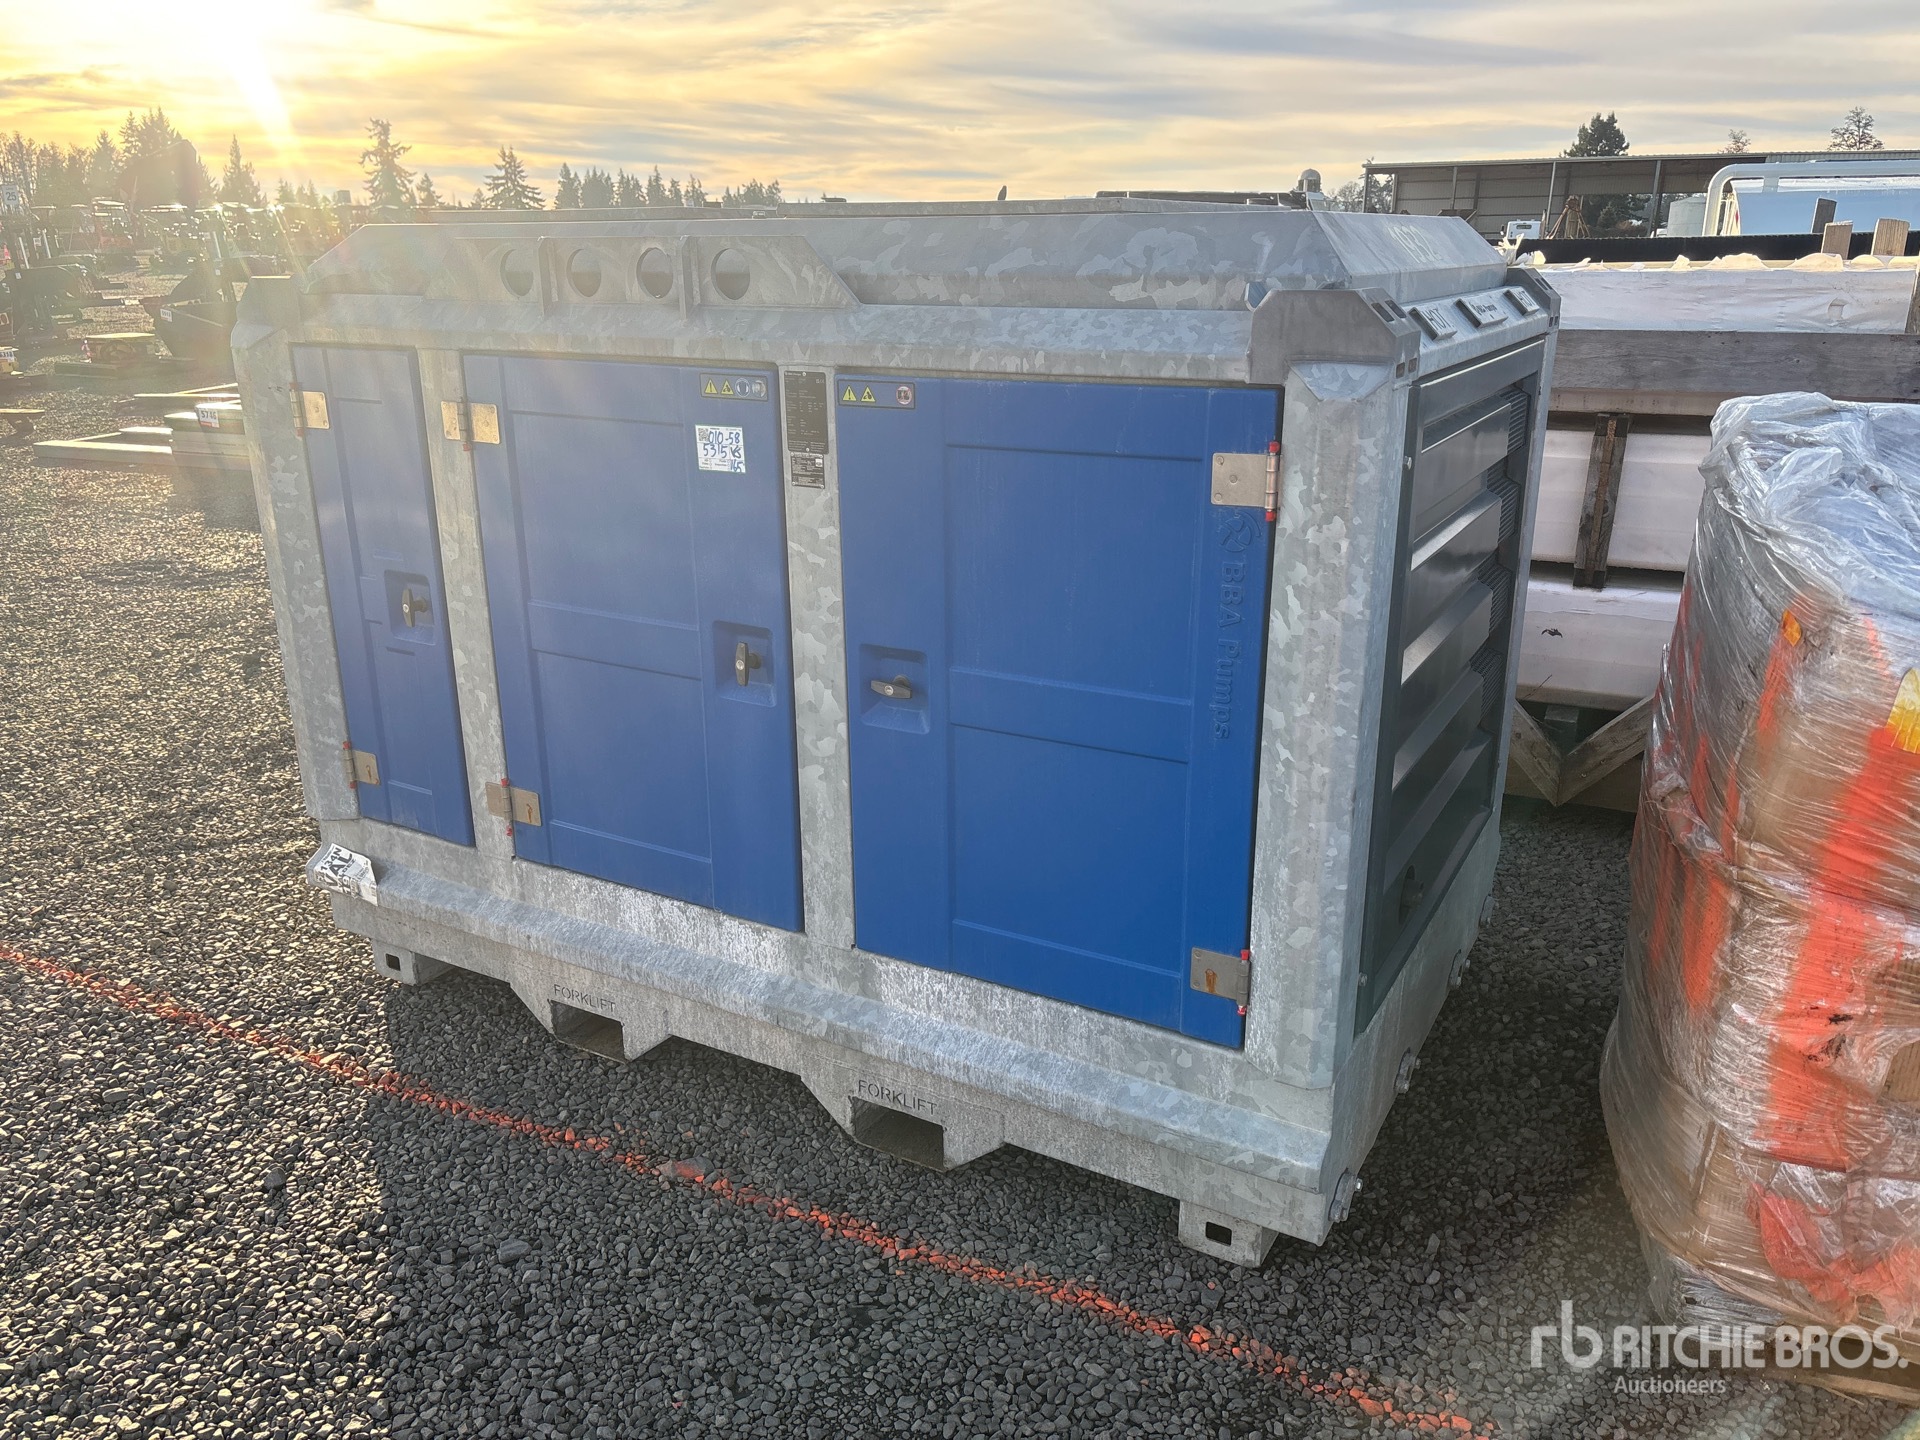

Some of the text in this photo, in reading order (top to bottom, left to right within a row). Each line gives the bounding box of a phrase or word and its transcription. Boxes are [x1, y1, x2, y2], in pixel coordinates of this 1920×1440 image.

[5, 191, 17, 201] 25
[1420, 308, 1452, 331] HOT
[1209, 561, 1246, 741] BBA Pumps
[552, 983, 616, 1013] FORKLIFT
[857, 1079, 938, 1116] FORKLIFT
